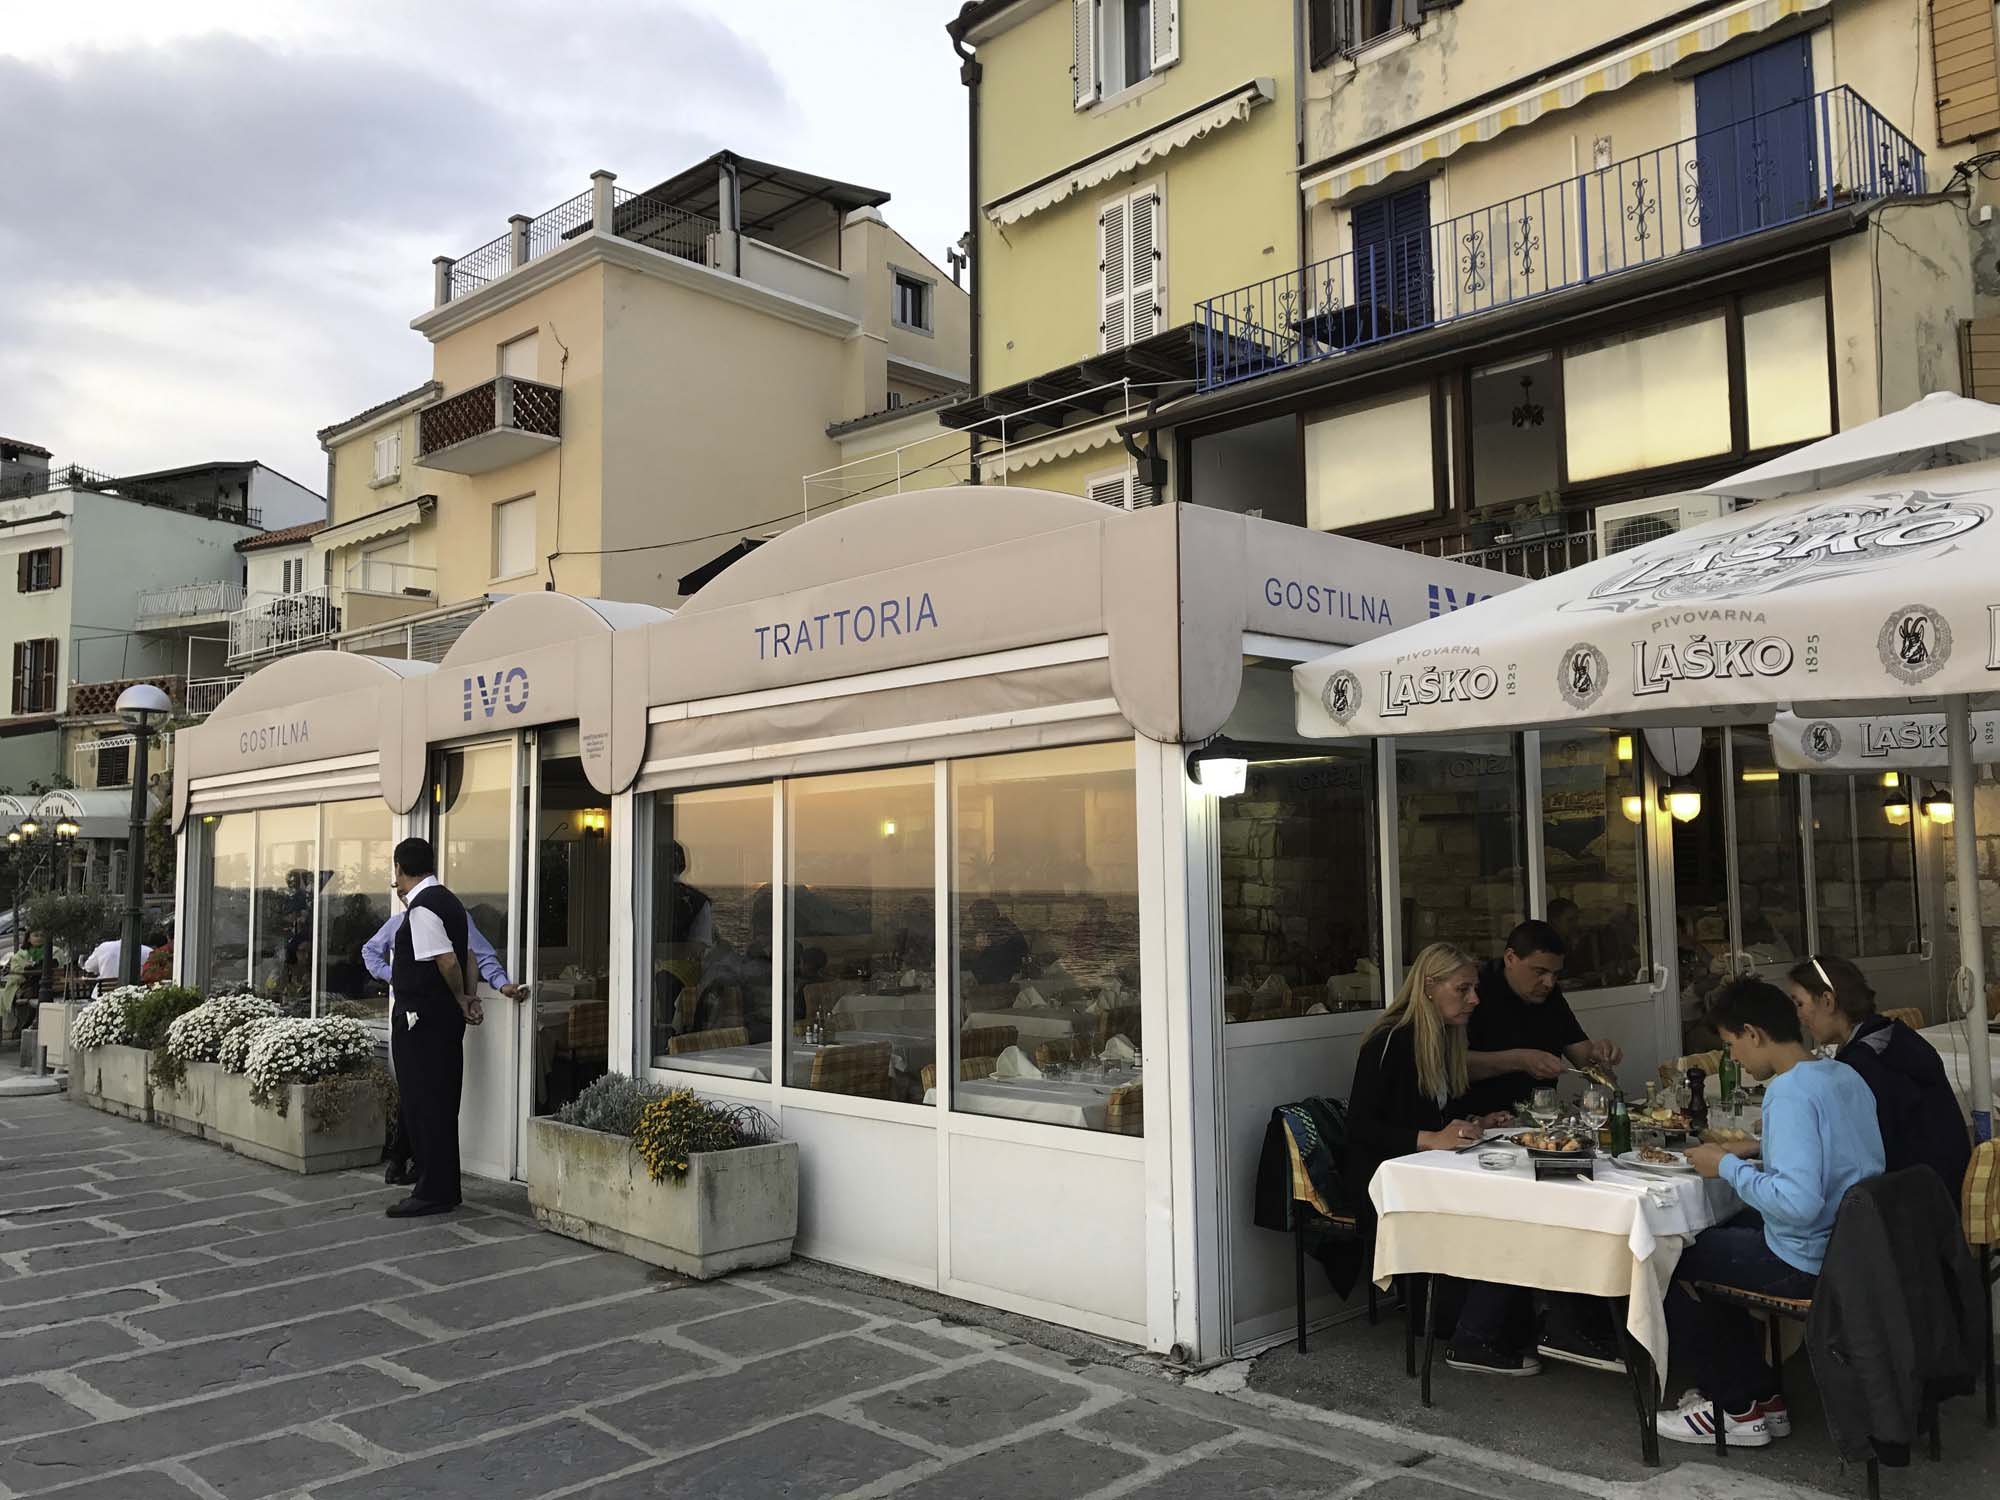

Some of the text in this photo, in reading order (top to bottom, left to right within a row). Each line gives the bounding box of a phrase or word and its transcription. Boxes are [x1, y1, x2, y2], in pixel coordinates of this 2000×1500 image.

[1265, 577, 1494, 626] GOSTILNA IV
[754, 593, 938, 660] TRATTORIA
[1651, 609, 1767, 633] PIVOVARNA
[1396, 645, 1481, 665] PIVOVARNA
[1632, 635, 1794, 697] LAŠKO
[1805, 634, 1820, 674] 1825
[464, 667, 529, 721] IVO
[1378, 666, 1498, 717] LAŠKO
[1507, 663, 1518, 696] 1825
[240, 720, 309, 753] GOSTILNA
[1859, 721, 1977, 758] LAŠK
[45, 805, 64, 816] RIVA
